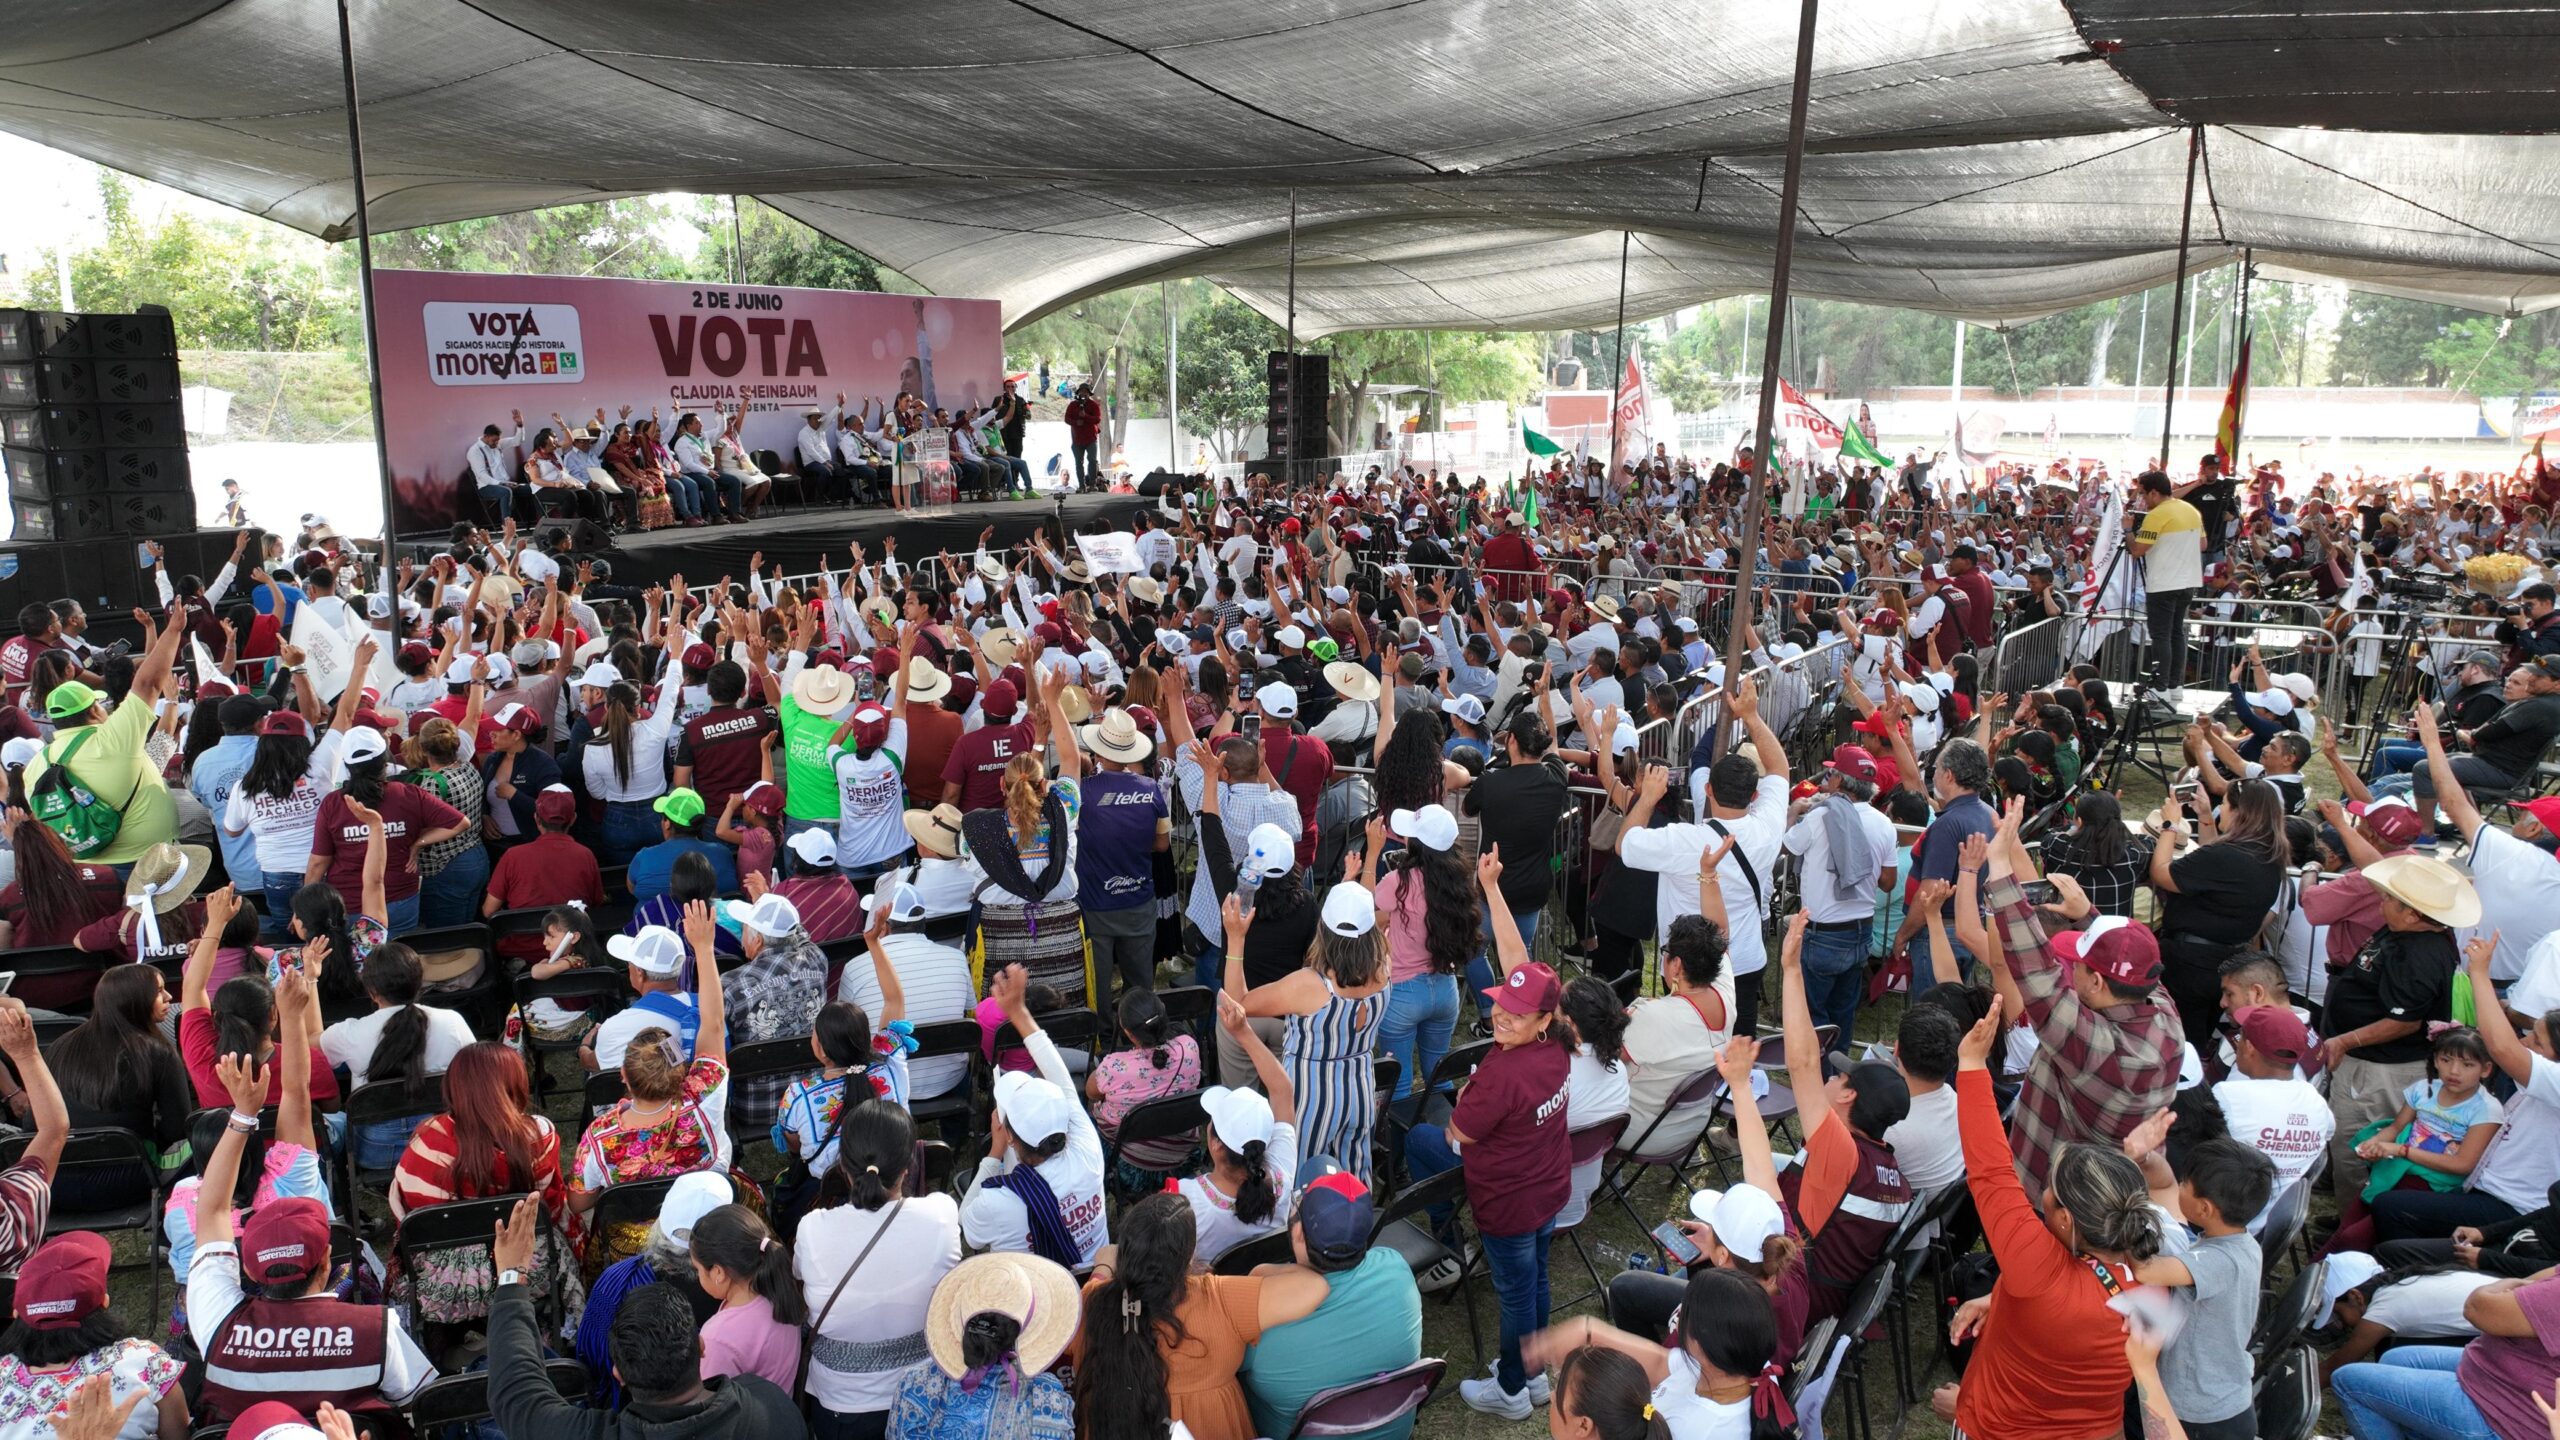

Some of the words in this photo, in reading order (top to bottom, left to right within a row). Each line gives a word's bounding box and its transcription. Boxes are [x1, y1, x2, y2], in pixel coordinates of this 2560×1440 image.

[692, 290, 703, 308] 2
[707, 291, 730, 309] DE
[735, 292, 783, 311] JUNIO
[468, 311, 540, 336] VOTA
[445, 341, 483, 350] SIGAMOS
[486, 341, 527, 350] HACIENDO
[529, 341, 566, 350] HISTORIA
[648, 314, 828, 378] VOTA
[436, 351, 537, 376] morena
[670, 384, 735, 400] CLAUDIA
[739, 384, 818, 399] SHEINBAUM
[3, 645, 28, 664] AMLO
[702, 716, 757, 736] morena
[845, 779, 896, 797] HERMES
[849, 788, 897, 804] PACHECO
[254, 788, 317, 810] HERMES
[1114, 791, 1154, 806] telcel
[257, 798, 321, 818] PACHECO
[343, 821, 406, 838] moena
[2260, 1127, 2321, 1143] CLAUDIA
[2256, 1139, 2320, 1153] SHEINBAUM
[228, 1324, 354, 1349] morena
[222, 1345, 234, 1355] La
[237, 1348, 292, 1359] esperanza
[295, 1348, 309, 1357] de
[312, 1346, 353, 1357] México
